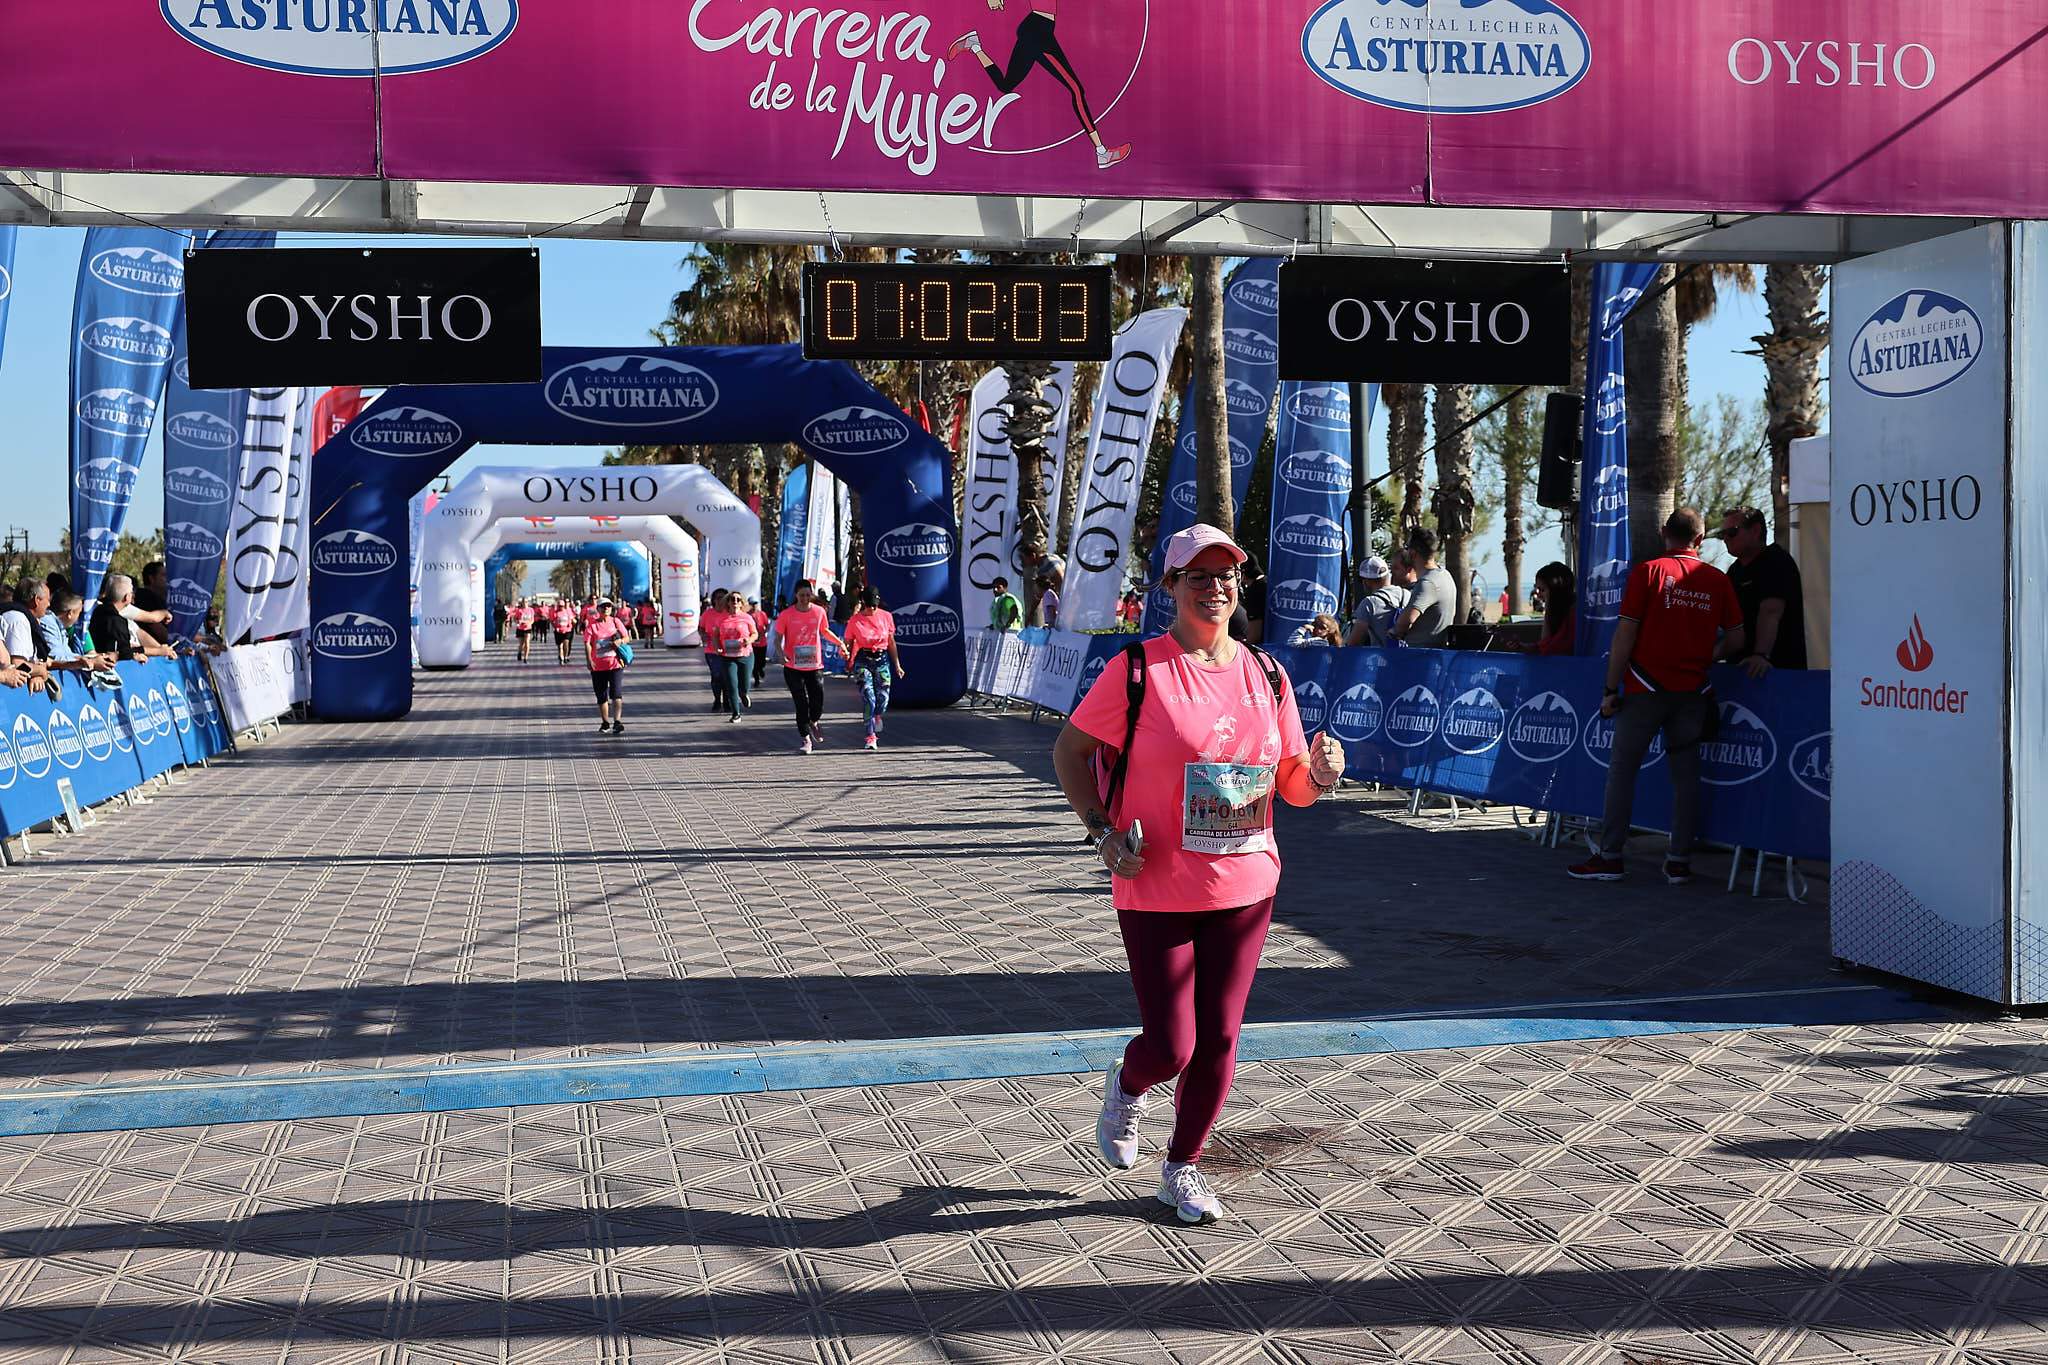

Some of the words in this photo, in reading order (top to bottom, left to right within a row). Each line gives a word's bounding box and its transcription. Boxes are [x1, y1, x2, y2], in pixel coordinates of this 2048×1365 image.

[688, 0, 932, 62] Carrera
[1370, 16, 1459, 32] CENTRAL
[1469, 19, 1559, 35] LECHERA
[1325, 17, 1569, 78] ASTURIANA
[1728, 38, 1937, 89] OYSHO
[749, 61, 794, 111] de
[806, 60, 837, 113] la
[831, 58, 1021, 177] Mujer
[246, 293, 492, 341] OYSHO
[1328, 298, 1530, 346] OYSHO
[1875, 327, 1917, 343] CENTRAL
[1921, 316, 1968, 335] LECHERA
[1226, 341, 1276, 362] STURIANA
[1857, 332, 1972, 377] ASTURIANA
[585, 376, 640, 385] CENTRAL
[645, 376, 700, 385] LECHERA
[558, 377, 706, 409] ASTURIANA
[171, 421, 233, 444] ASTURIANA
[357, 425, 453, 444] ASTURIANA
[812, 425, 902, 444] ASTURIANA
[1075, 351, 1159, 573] OYSHO
[166, 477, 225, 500] ASTURIANA
[523, 475, 658, 503] OYSHO
[968, 406, 1011, 590] OYSHO
[1851, 474, 1981, 526] OYSHO
[441, 508, 484, 517] OYSHO
[696, 503, 737, 513] OYSHO
[169, 535, 217, 555] STURIANA
[315, 547, 391, 566] ASTURIANA
[881, 541, 951, 558] ASTURIANA
[424, 562, 463, 571] OYSHO
[718, 558, 755, 567] OYSHO
[424, 616, 463, 625] OYSHO
[896, 619, 957, 637] STURIANA
[315, 630, 391, 647] ASTURIANA
[1042, 643, 1079, 679] OYSHO
[1860, 676, 1969, 715] Santander
[1332, 704, 1378, 728] ASTURIANA
[1387, 707, 1434, 732] ASTURIANA
[1445, 711, 1498, 738] ASTURIANA
[1511, 717, 1571, 745] ASTURIANA
[1194, 839, 1226, 849] OYSHO
